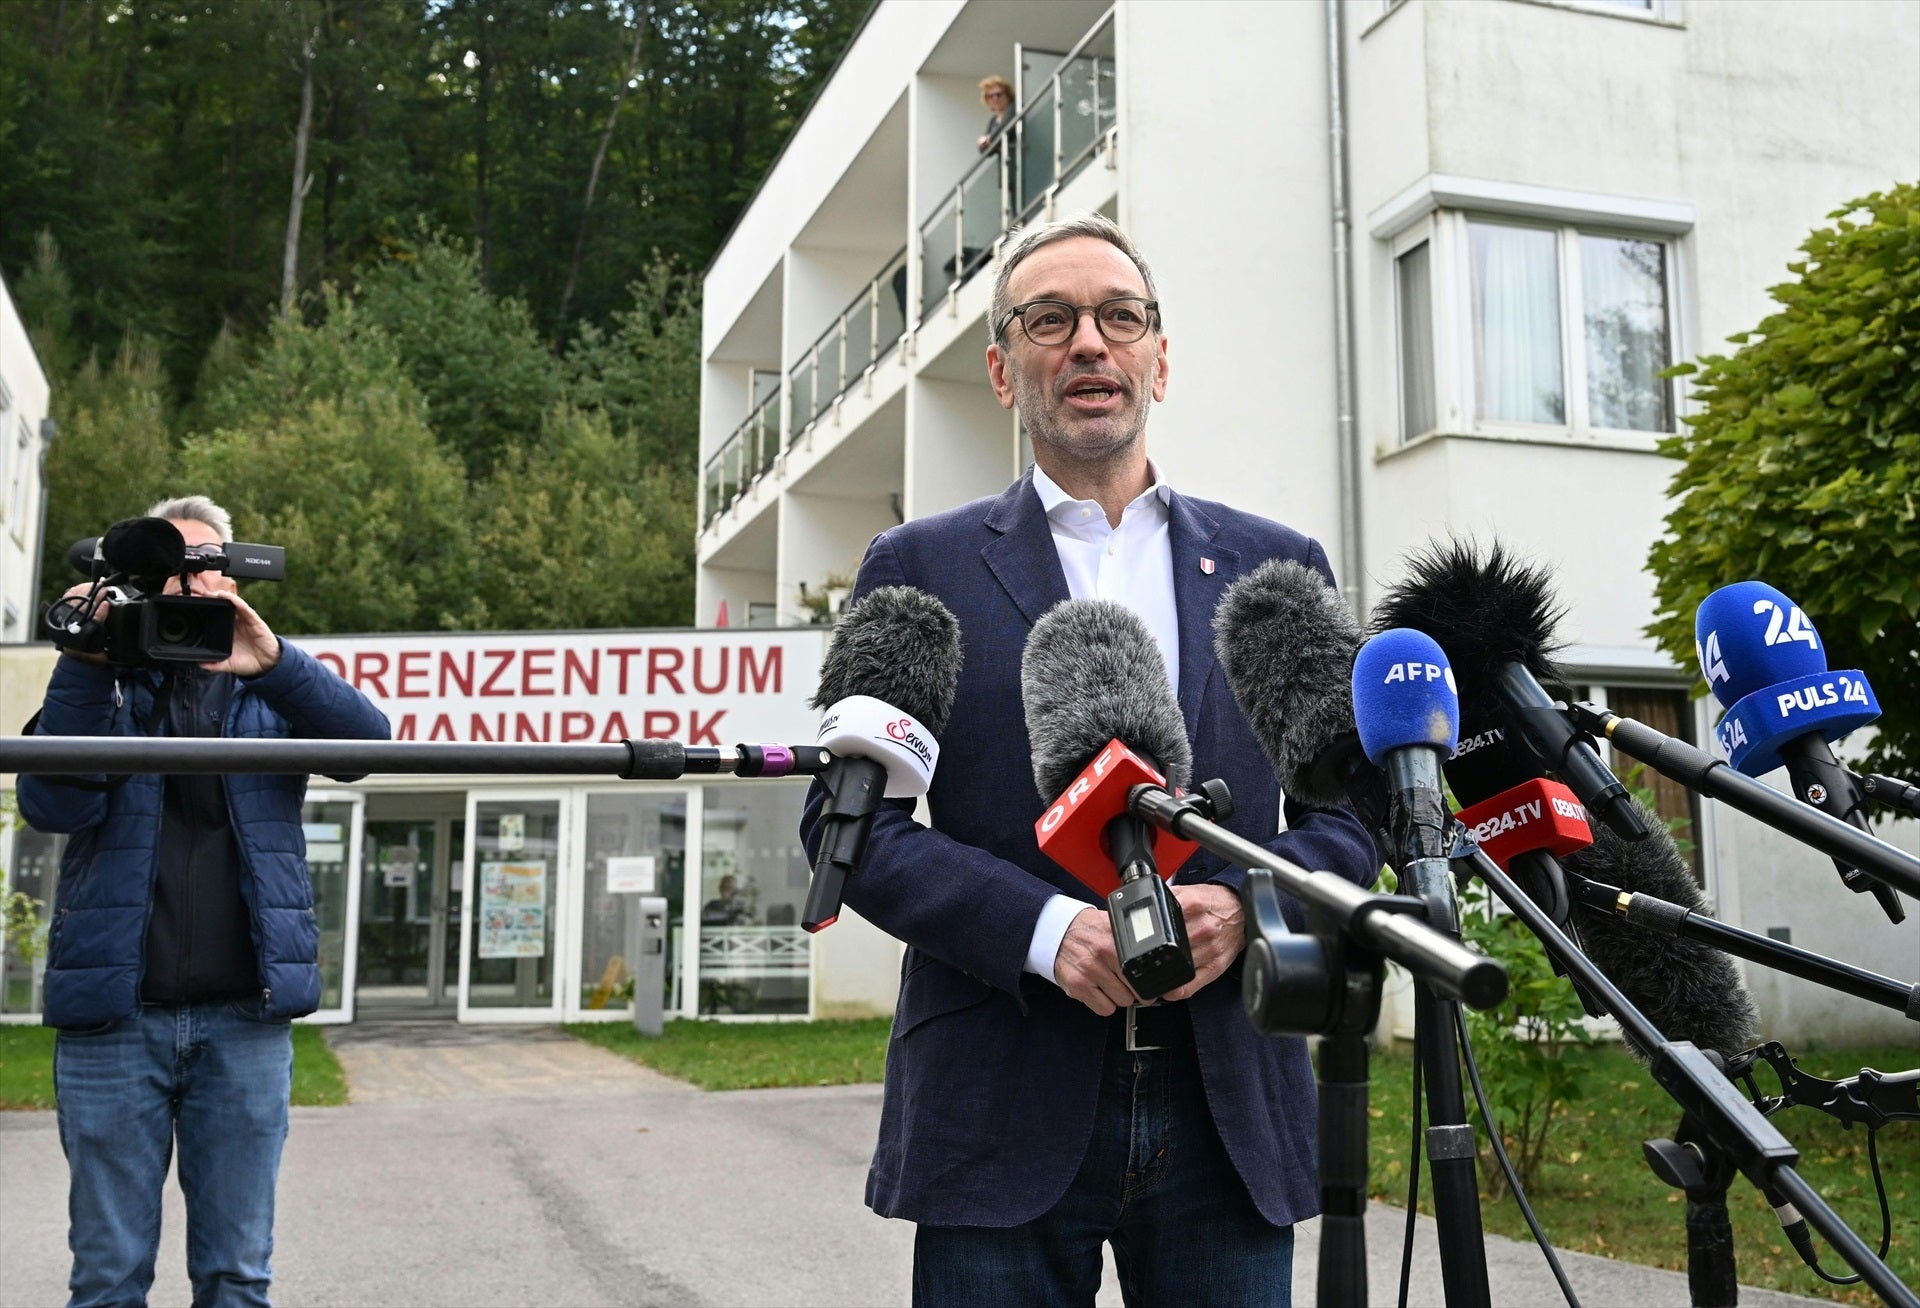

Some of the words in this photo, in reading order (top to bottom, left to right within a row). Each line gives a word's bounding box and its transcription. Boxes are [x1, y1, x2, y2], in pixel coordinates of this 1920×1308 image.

[1753, 599, 1818, 650] 24
[1383, 662, 1442, 685] AFP
[1776, 683, 1839, 718] PULS
[1838, 676, 1869, 706] 24
[1041, 747, 1112, 833] ORF
